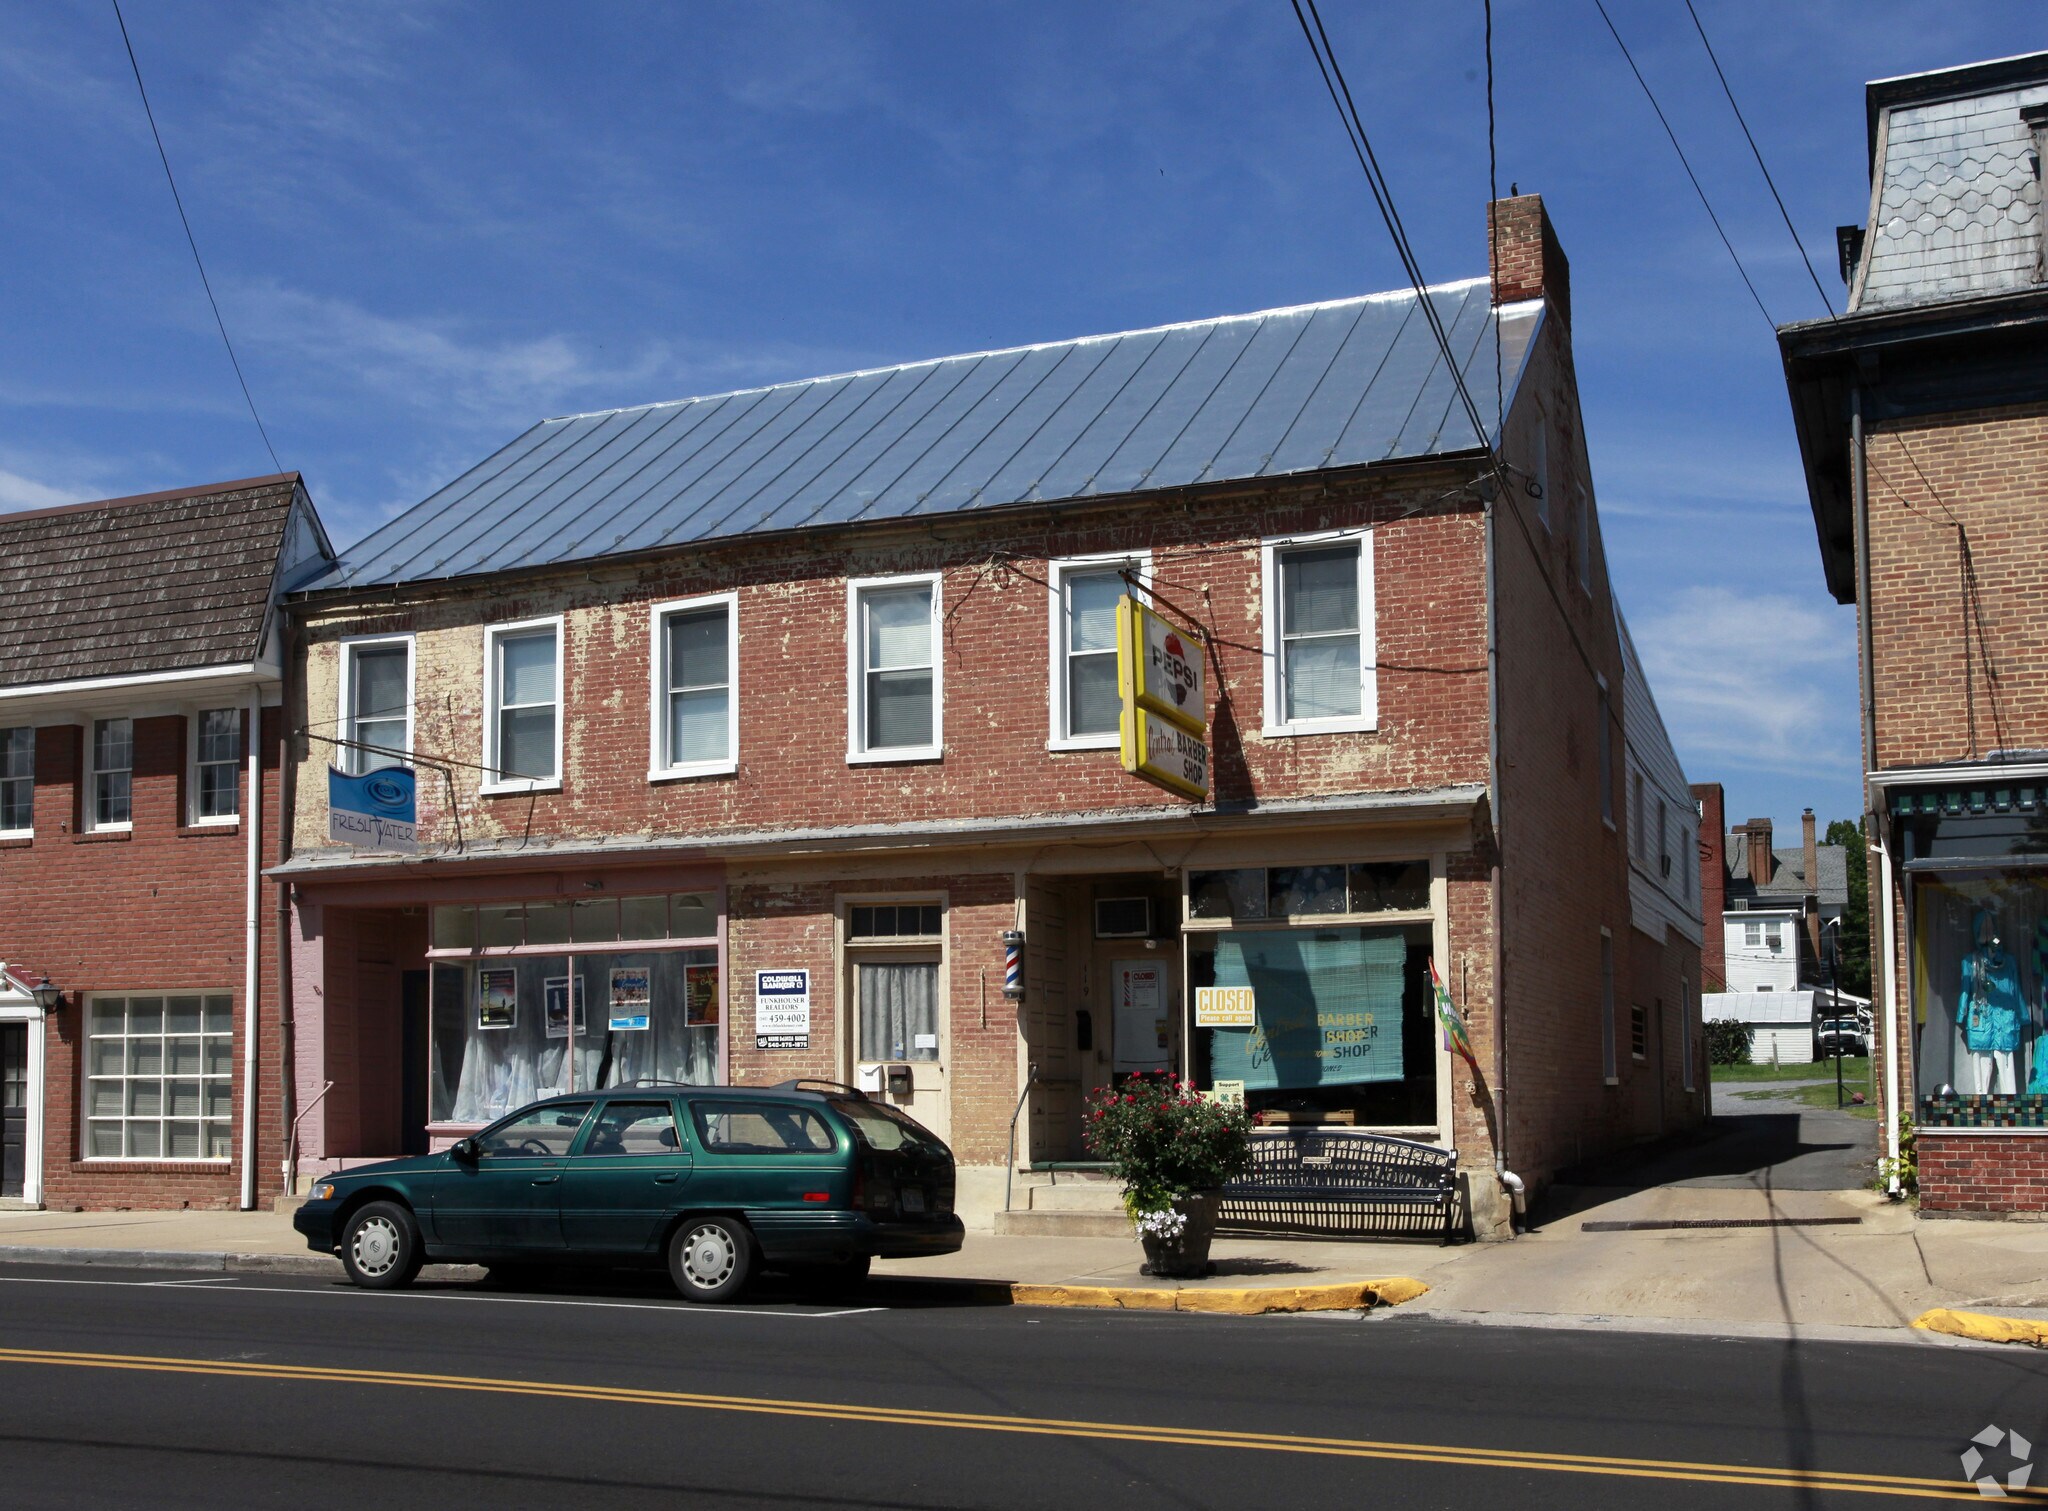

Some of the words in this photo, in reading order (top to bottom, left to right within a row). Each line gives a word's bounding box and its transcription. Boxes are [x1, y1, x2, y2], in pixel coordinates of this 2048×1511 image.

[1152, 644, 1198, 692] PEPSI
[1148, 725, 1175, 760] Central
[1177, 731, 1207, 766] BARBER
[1183, 758, 1203, 786] SHOP
[1134, 972, 1155, 980] CLOSED
[1198, 989, 1253, 1012] CLOSED
[769, 1013, 806, 1023] 459-4002
[1200, 1014, 1220, 1022] Please
[1221, 1014, 1233, 1022] call
[1234, 1014, 1252, 1023] again
[1317, 1013, 1375, 1027] BARBER
[1326, 1030, 1367, 1044] SHOP
